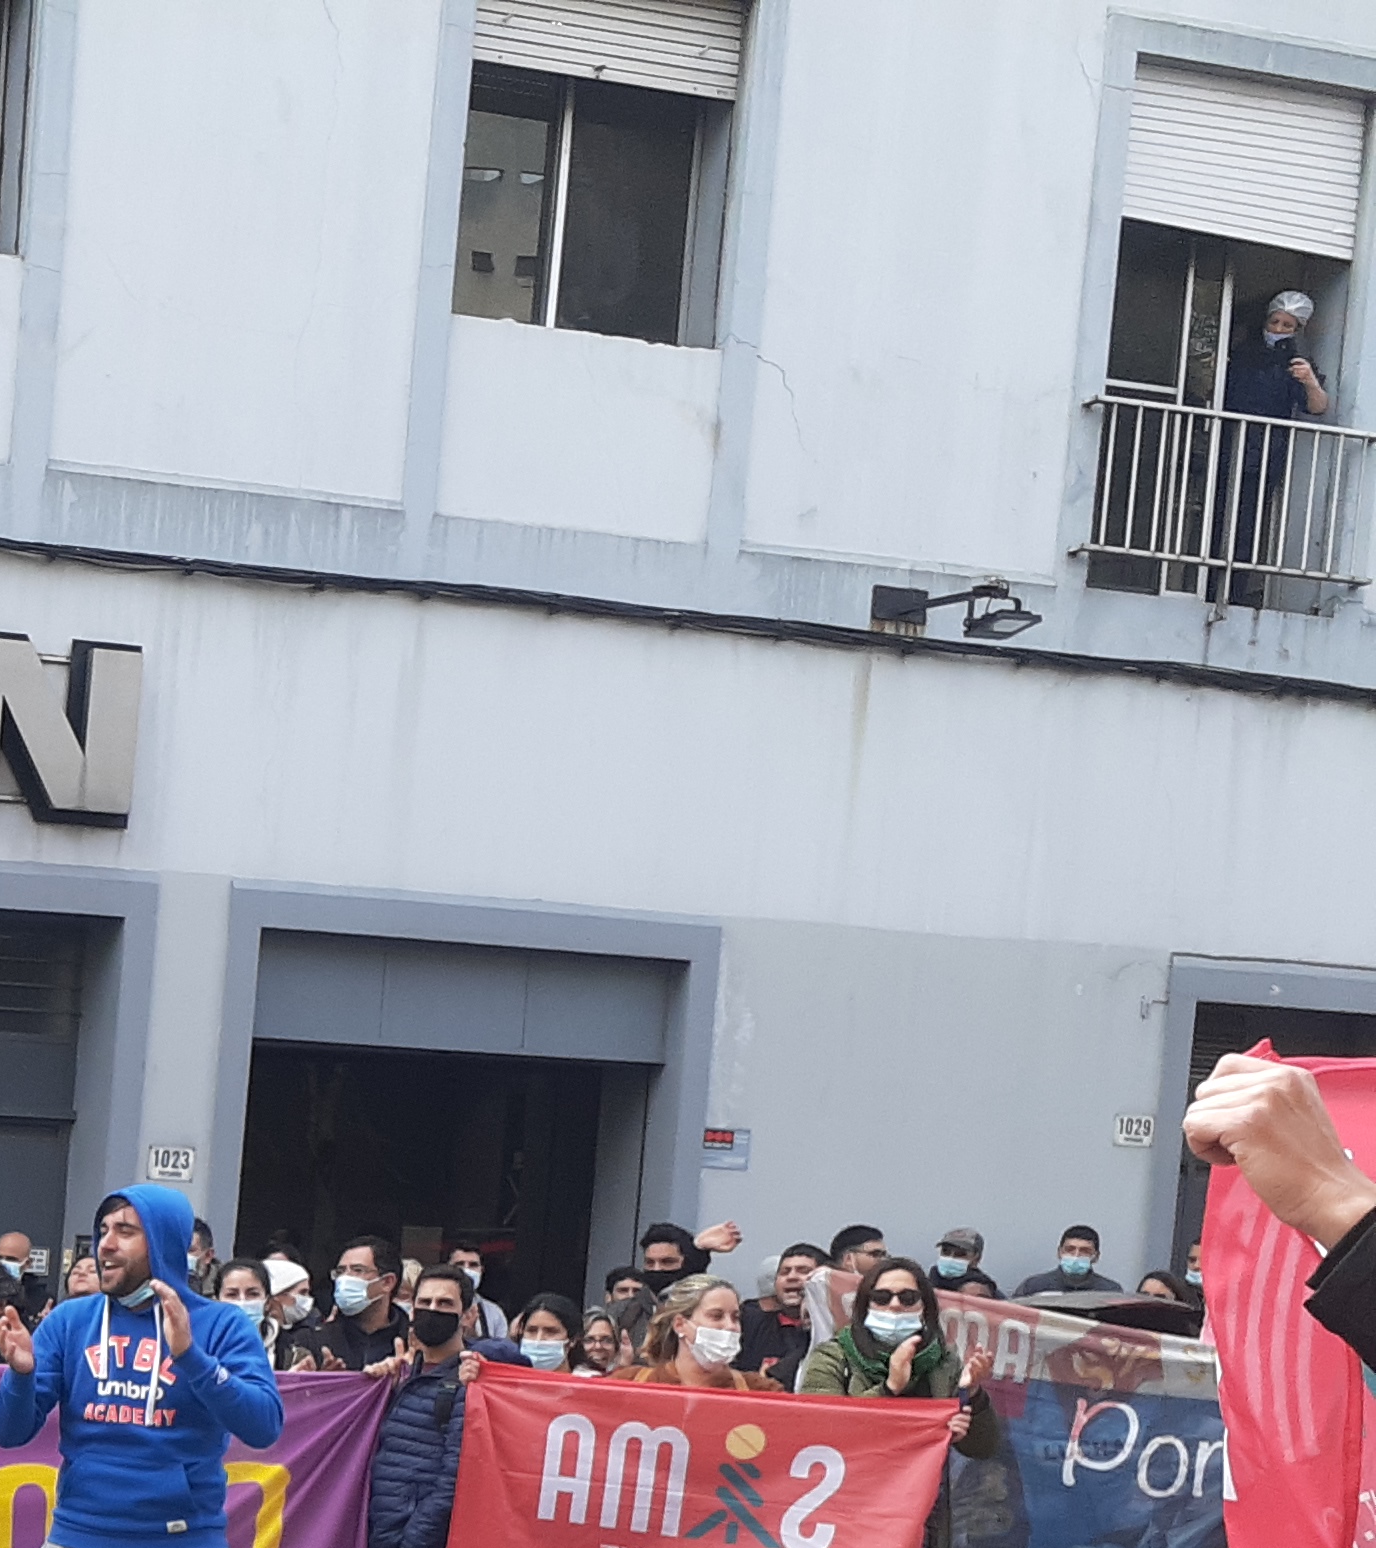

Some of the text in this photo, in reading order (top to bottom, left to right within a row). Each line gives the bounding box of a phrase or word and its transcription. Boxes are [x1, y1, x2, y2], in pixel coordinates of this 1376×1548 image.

[1119, 1118, 1152, 1137] 1029
[154, 1149, 190, 1170] 1023
[97, 1380, 165, 1400] umbro
